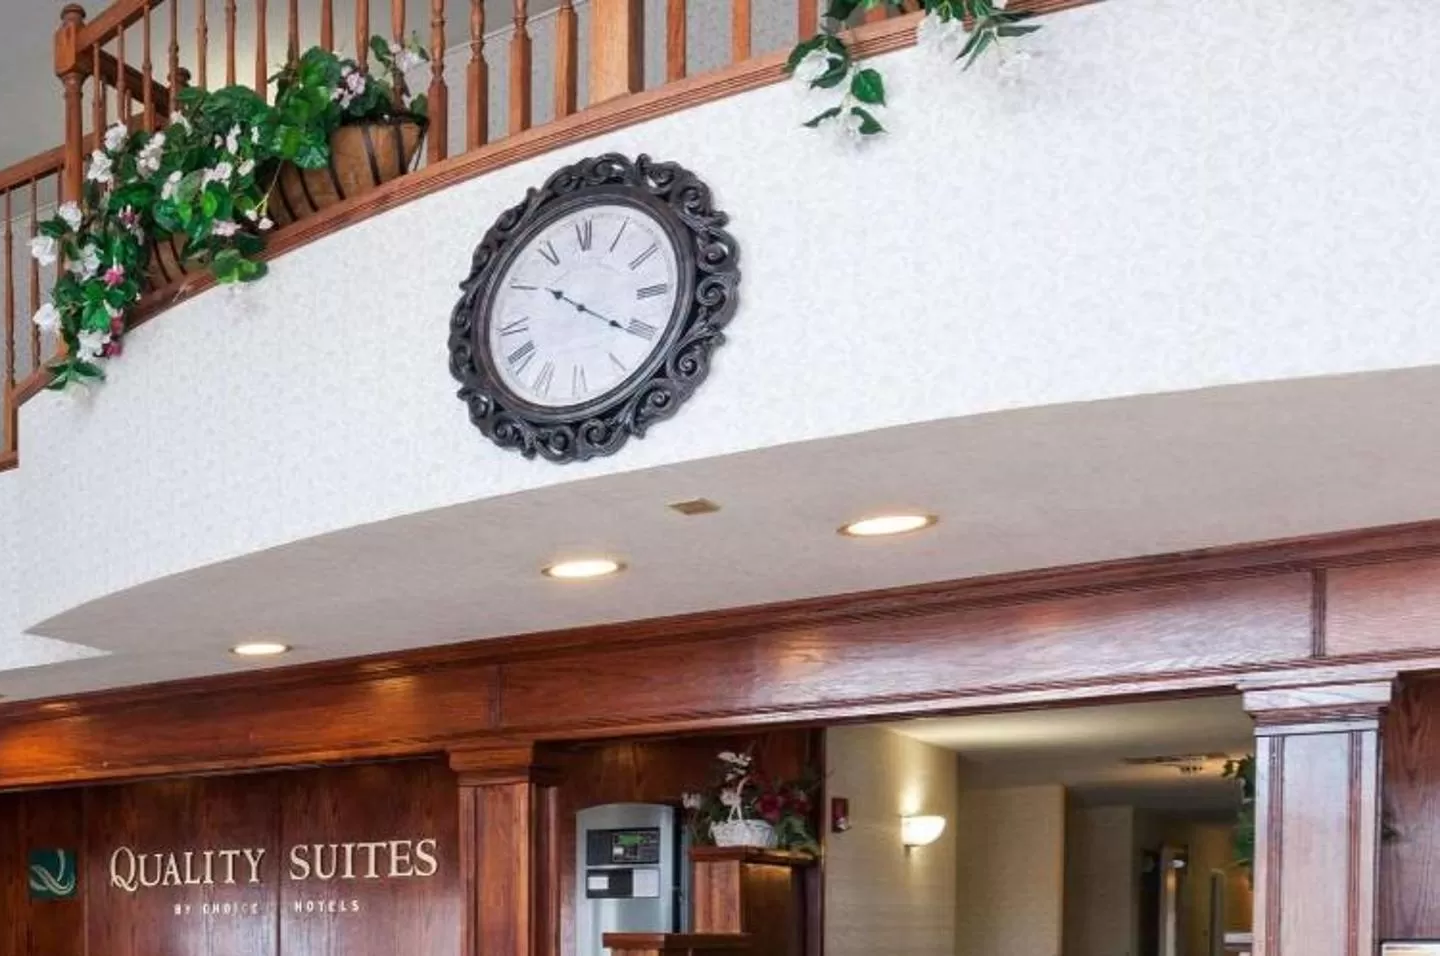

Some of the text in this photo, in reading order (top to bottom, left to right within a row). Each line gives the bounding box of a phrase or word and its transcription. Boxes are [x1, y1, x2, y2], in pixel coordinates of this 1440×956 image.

[110, 838, 438, 892] QUALITY SUITES
[295, 900, 360, 913] HOTELS
